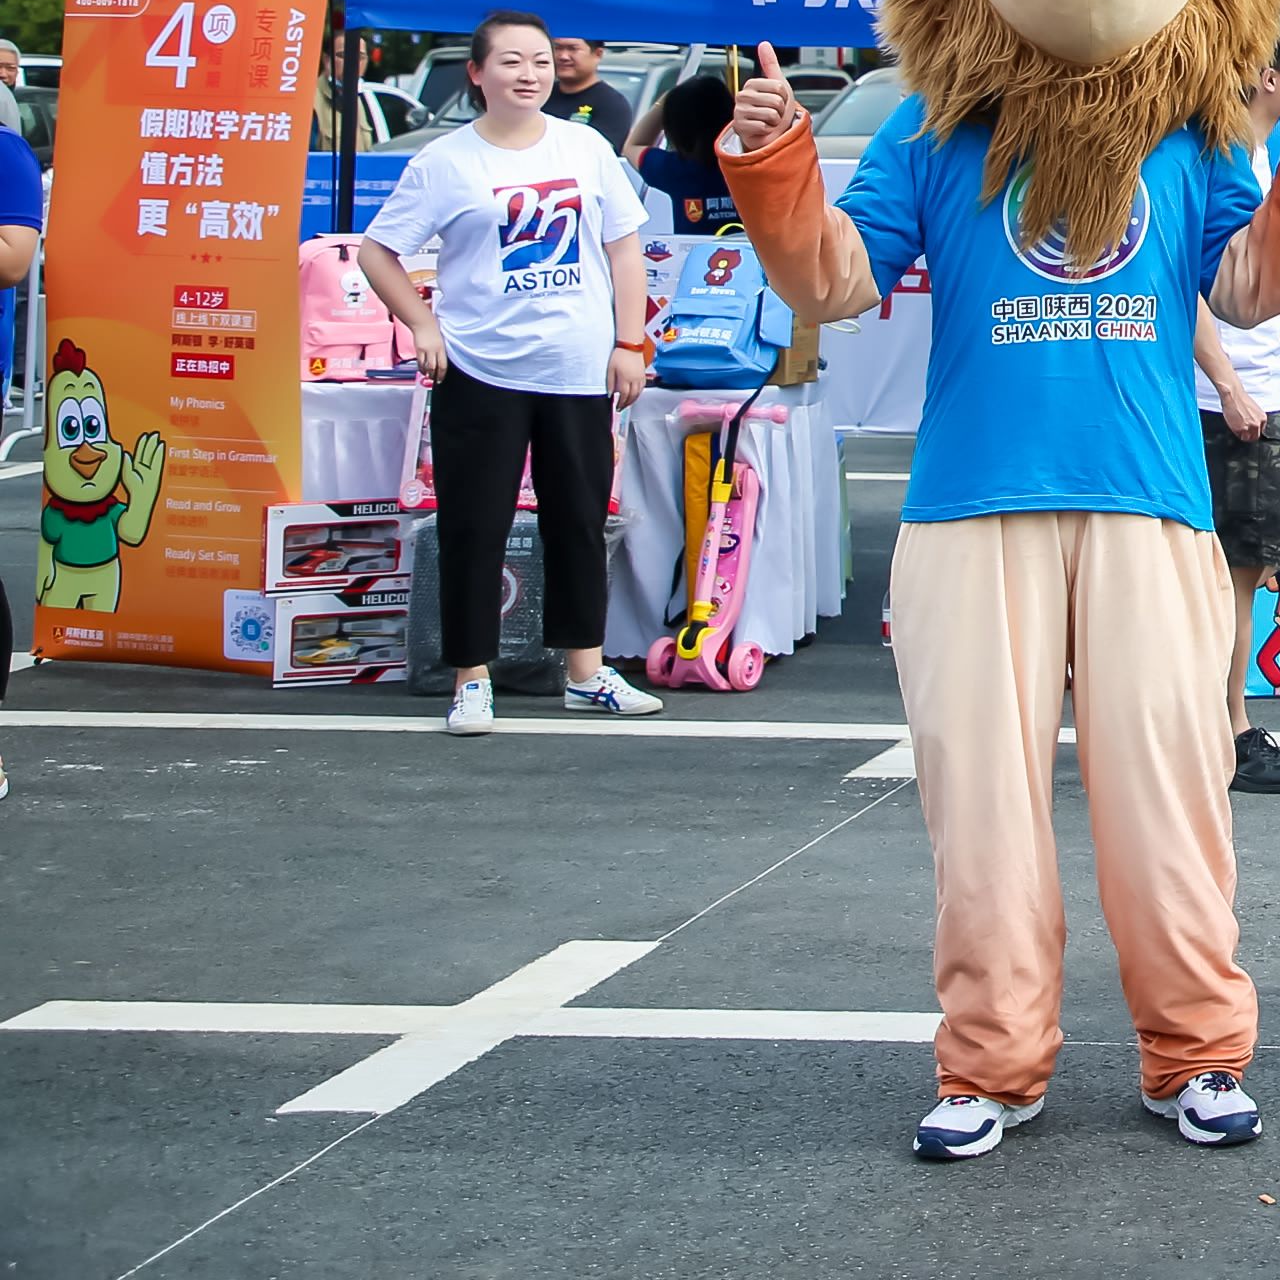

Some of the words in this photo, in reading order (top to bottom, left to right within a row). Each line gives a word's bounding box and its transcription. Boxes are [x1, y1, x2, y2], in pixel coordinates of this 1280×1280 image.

[209, 12, 230, 37] 项
[145, 1, 197, 89] 4
[279, 7, 306, 92] ASTON
[140, 108, 292, 142] 假期班学方法
[139, 151, 224, 187] 懂方法
[504, 267, 580, 293] ASTON
[179, 291, 225, 308] 4-12岁
[992, 297, 1038, 320] 中国
[1044, 295, 1090, 317] 陕西
[1097, 295, 1156, 318] 2021
[993, 322, 1090, 342] SHAANXI
[1097, 322, 1155, 339] CHINA
[170, 396, 184, 410] My
[186, 397, 225, 410] Phonics
[168, 447, 190, 459] First
[192, 448, 215, 462] Step
[217, 450, 226, 460] in
[228, 450, 279, 463] Grammar
[166, 498, 191, 510] Read
[193, 500, 212, 511] and
[214, 500, 241, 513] Grow
[165, 548, 195, 562] Ready
[198, 550, 214, 561] Set
[217, 551, 240, 565] Sing
